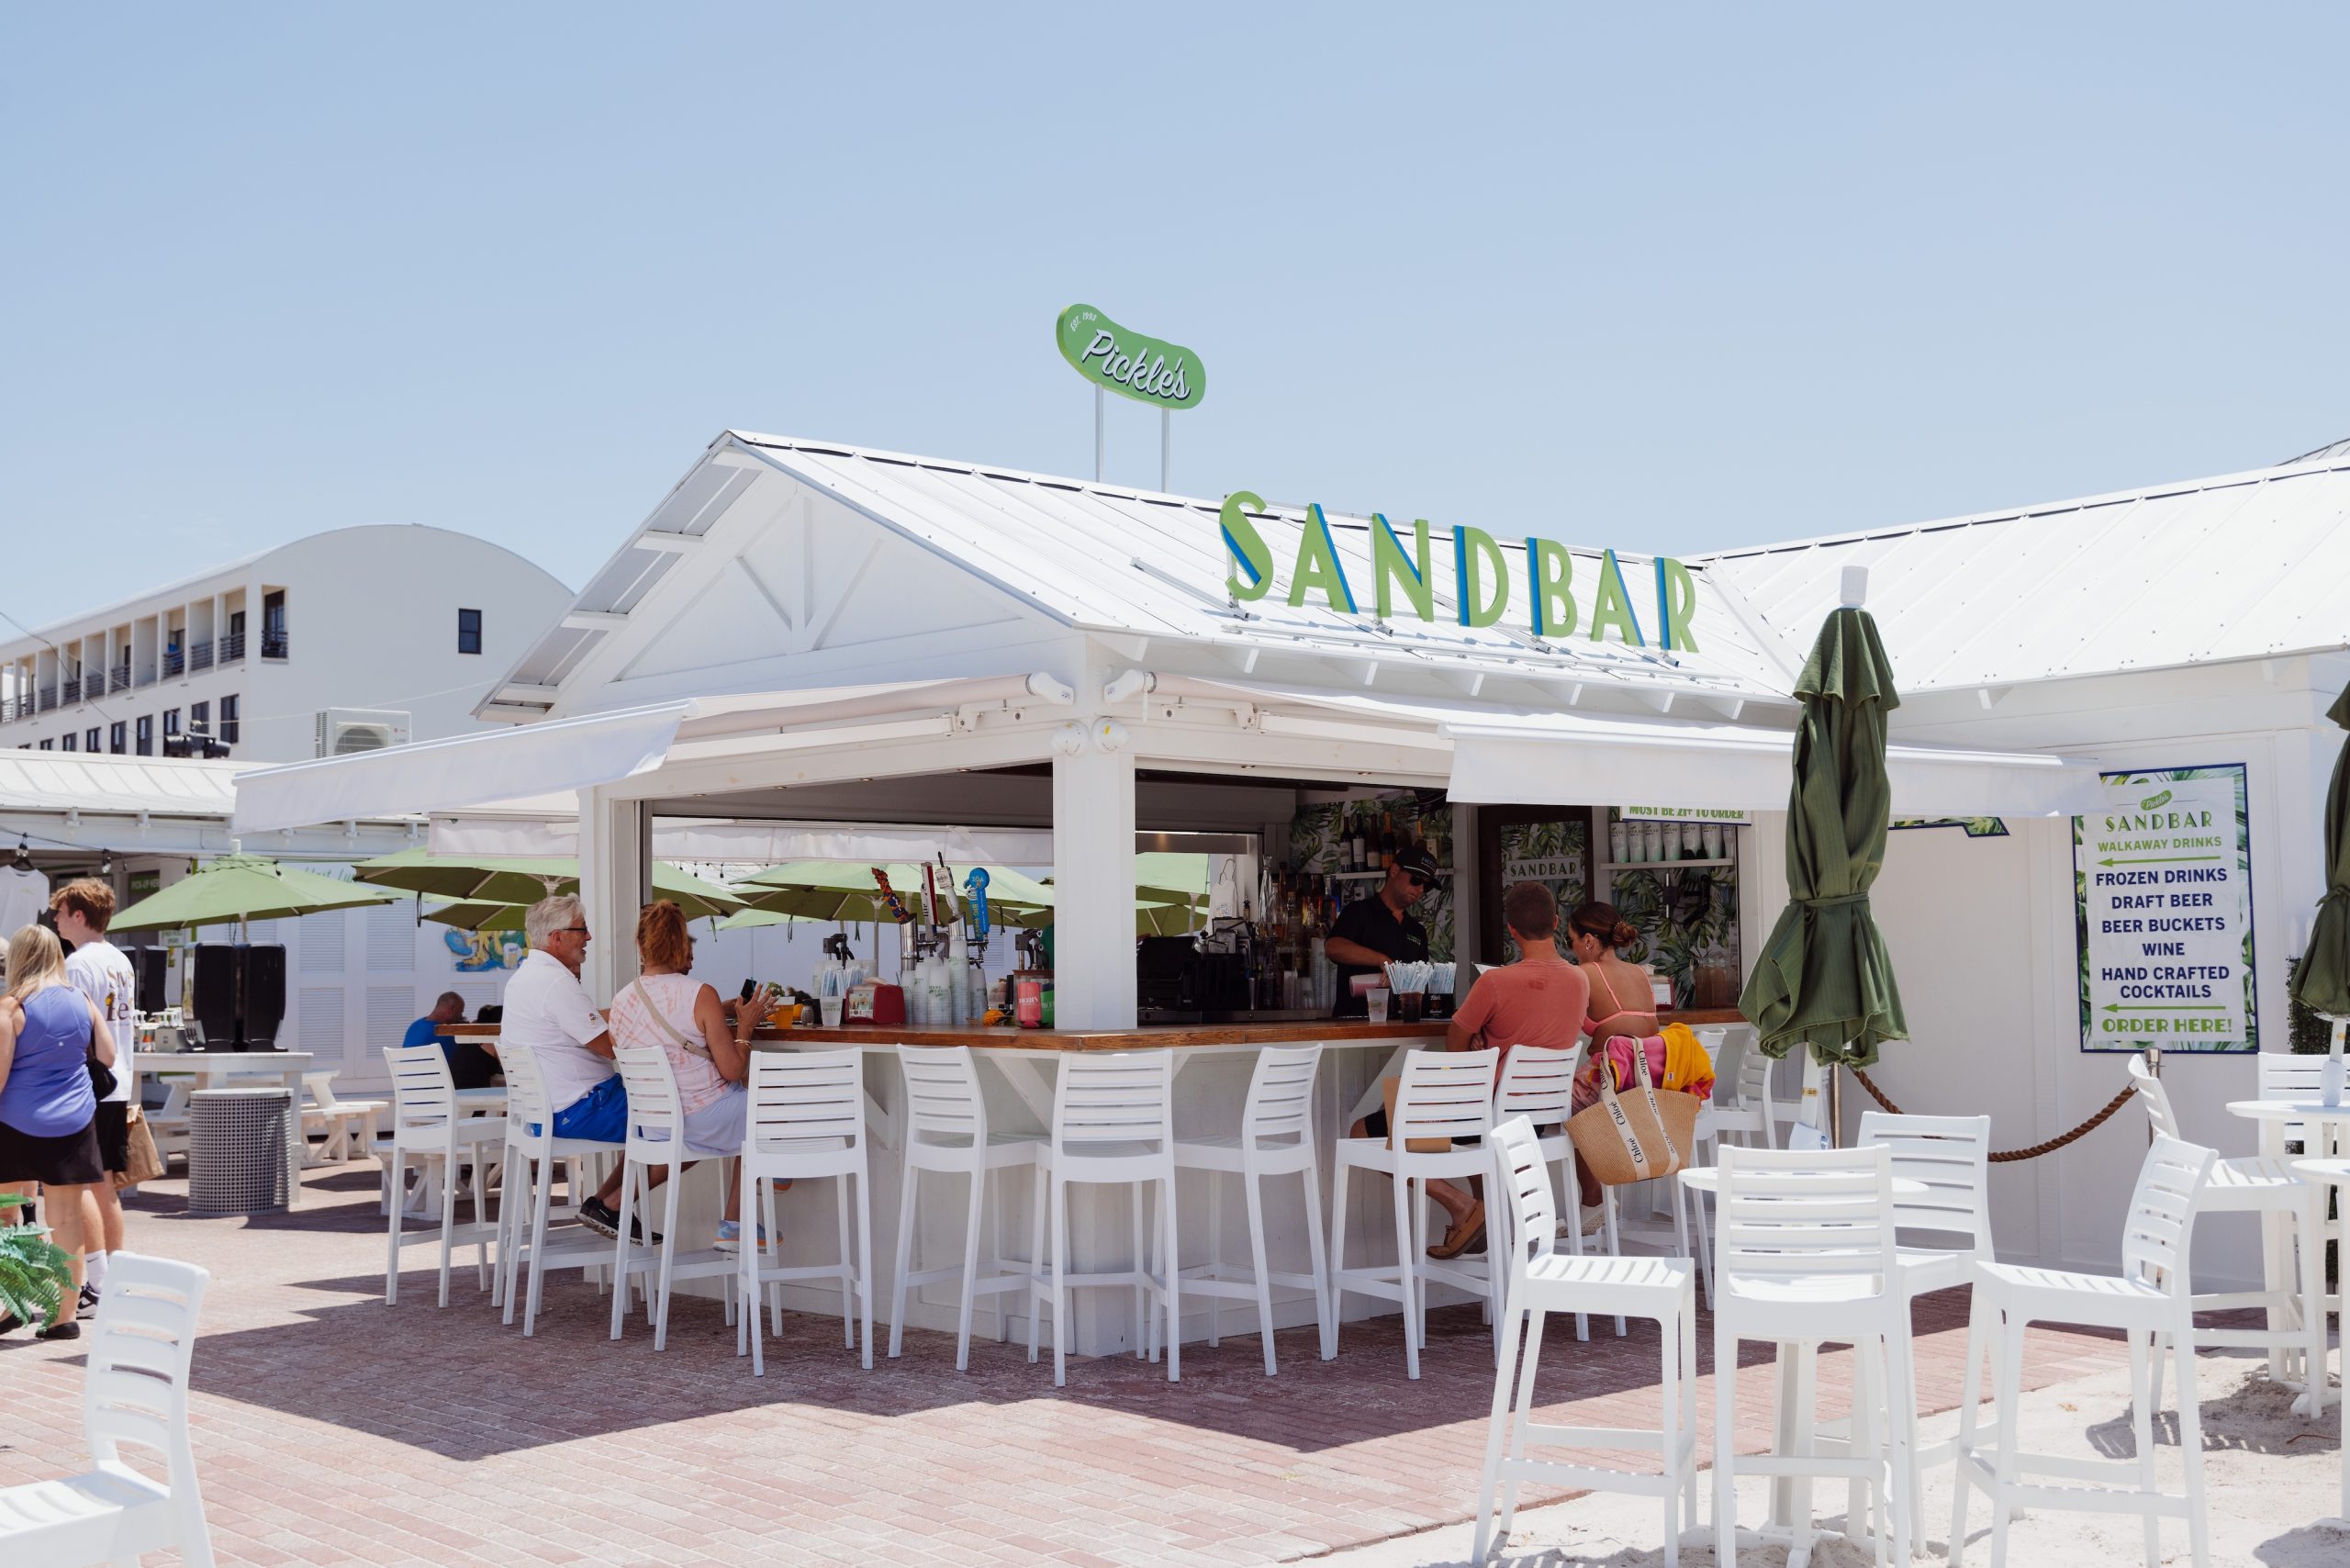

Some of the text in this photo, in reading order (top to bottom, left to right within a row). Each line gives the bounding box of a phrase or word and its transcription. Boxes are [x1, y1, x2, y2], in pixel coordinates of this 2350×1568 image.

[1081, 329, 1191, 400] Pickle's
[1219, 490, 1699, 653] SANDBAR
[2106, 811, 2212, 832] SANDBAR
[2098, 836, 2221, 852] WALKAWAY DRINKS
[1510, 861, 1577, 878] SANDBAR
[2096, 868, 2227, 886] FROZEN DRINKS
[2111, 892, 2213, 909] DRAFT BEER
[2102, 917, 2225, 934] BEER BUCKETS
[2143, 942, 2185, 956] WINE
[2102, 966, 2230, 981] HAND CRAFTED
[2121, 984, 2211, 999] COCKTAILS
[2102, 1018, 2232, 1033] ORDER HERE!
[1638, 1050, 1648, 1076] Chloé
[1608, 1102, 1626, 1126] Chloé
[1627, 1137, 1643, 1163] Chloé
